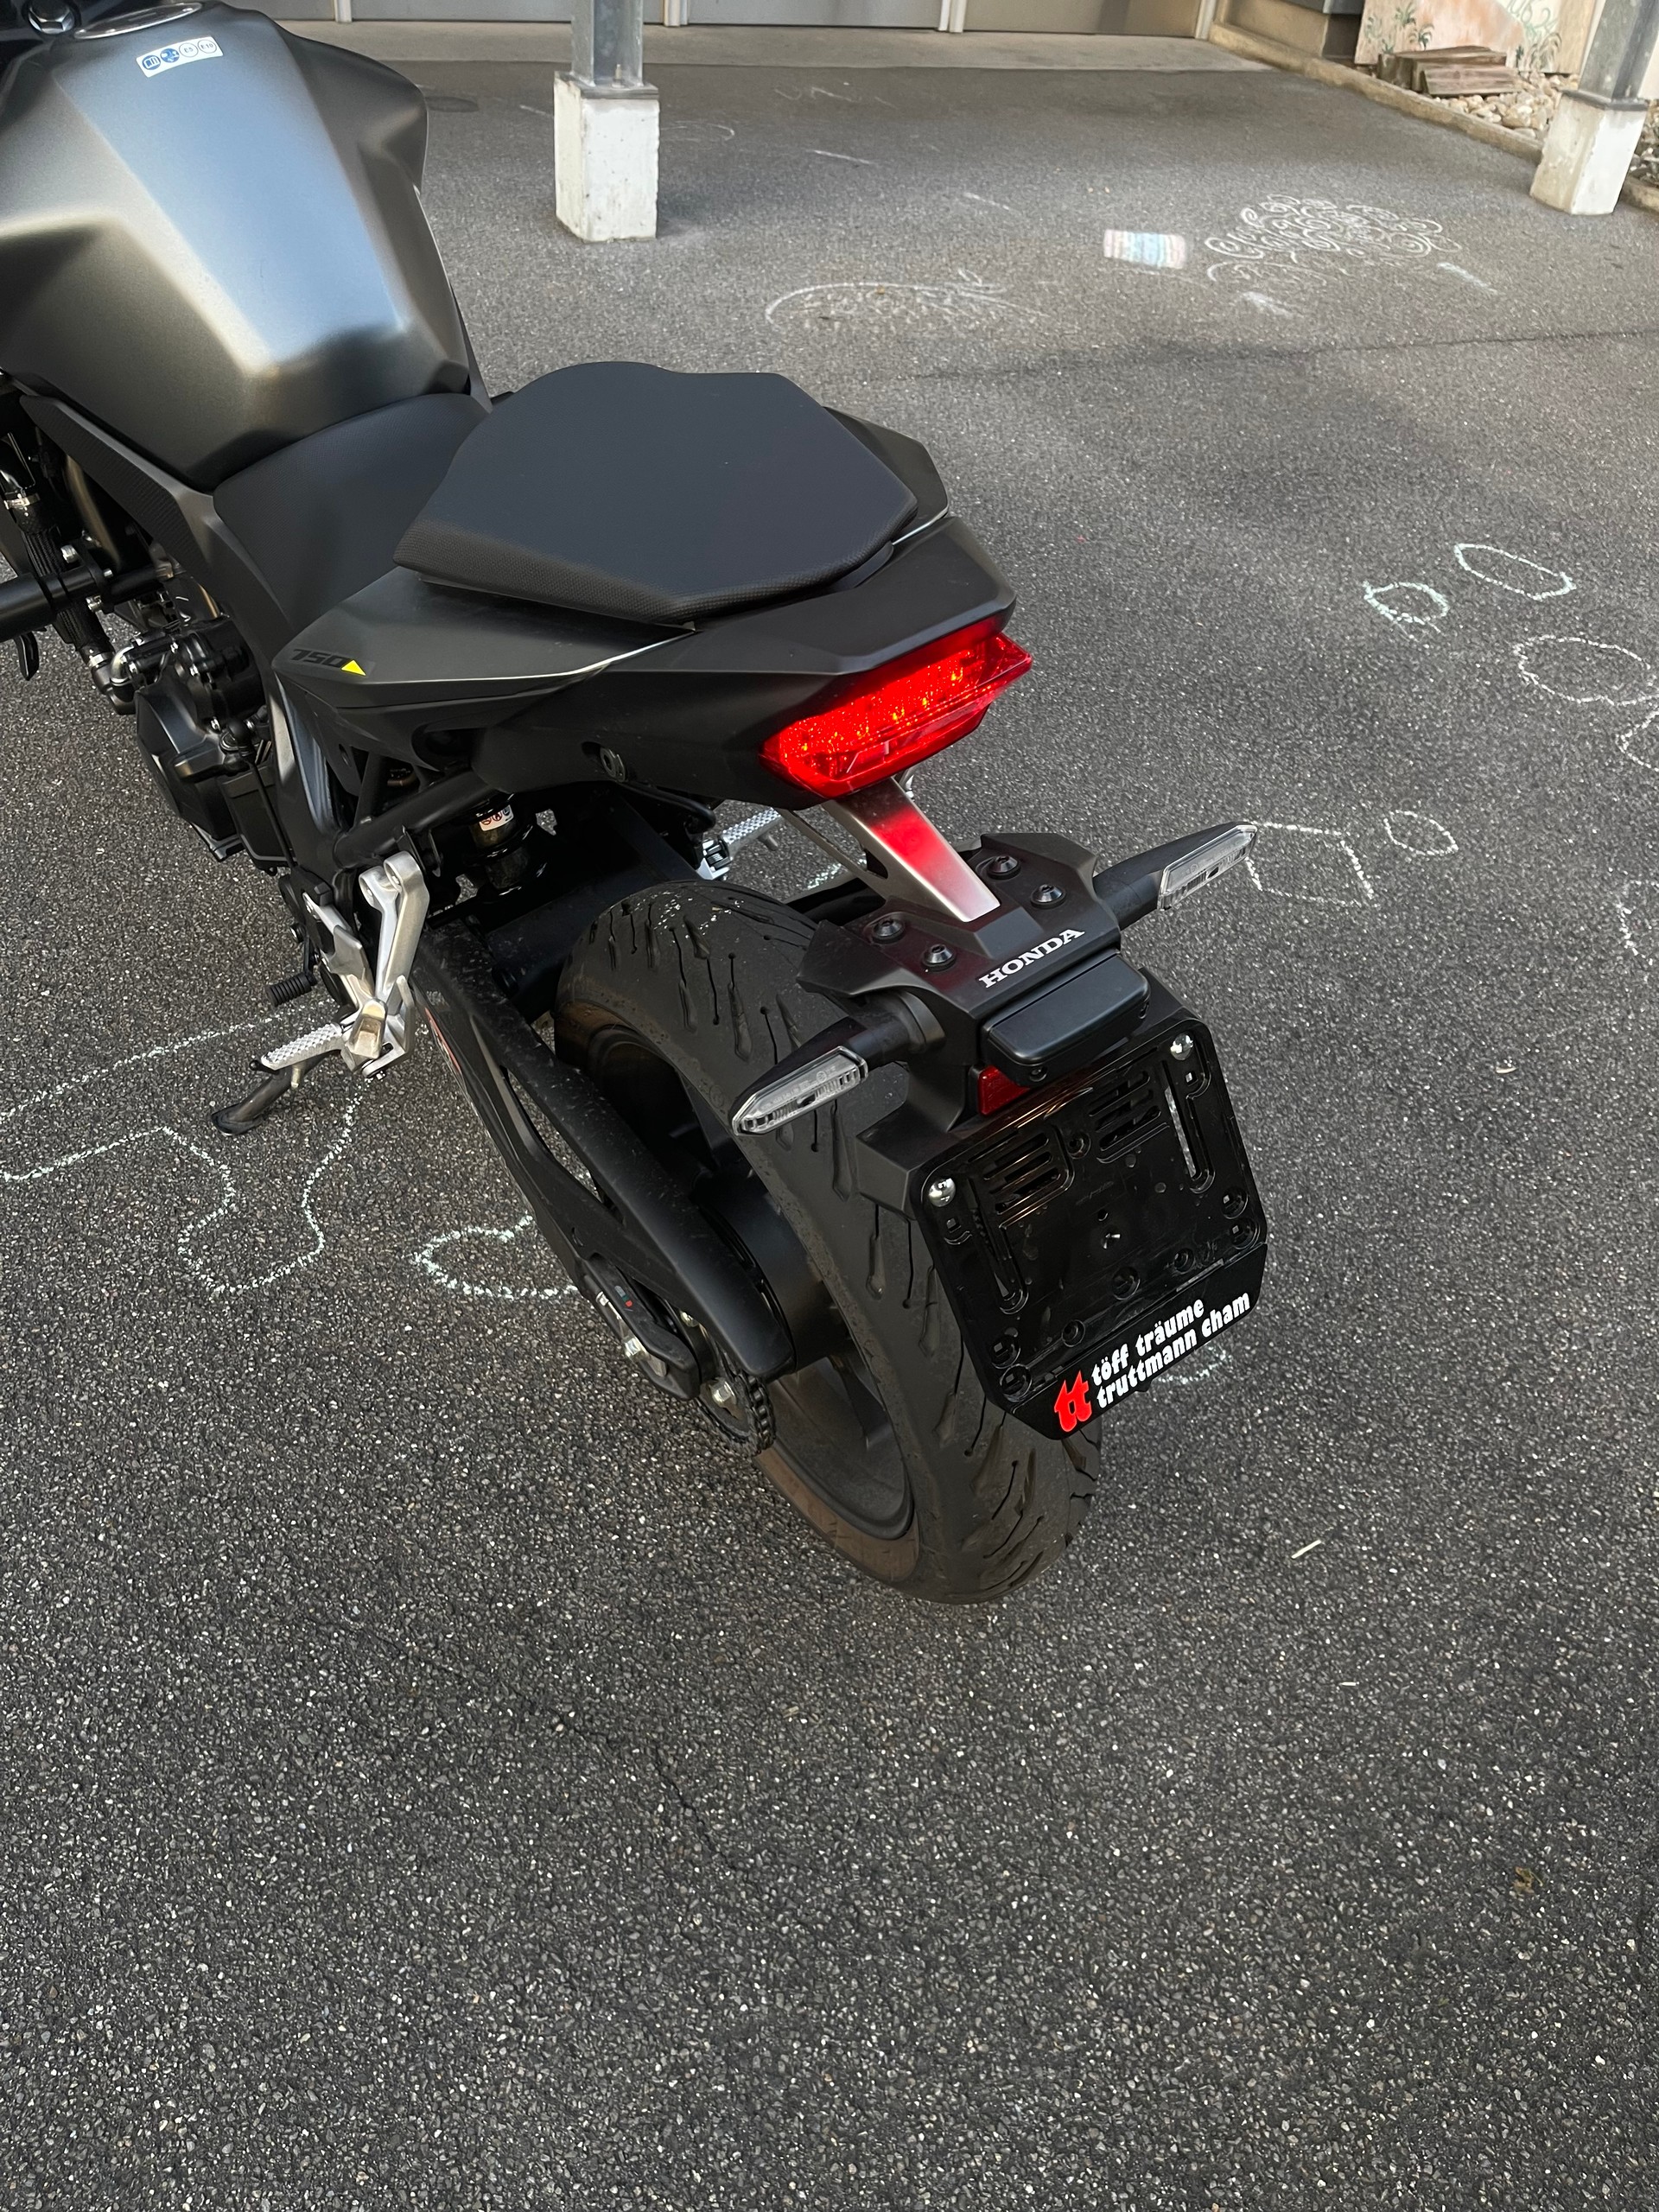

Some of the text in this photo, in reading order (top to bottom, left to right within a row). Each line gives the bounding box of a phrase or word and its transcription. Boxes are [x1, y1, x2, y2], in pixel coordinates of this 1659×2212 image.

[291, 649, 351, 669] 750
[978, 929, 1085, 988] HONDA
[1091, 1299, 1205, 1386] töff träume
[1096, 1293, 1250, 1408] truttmann cham
